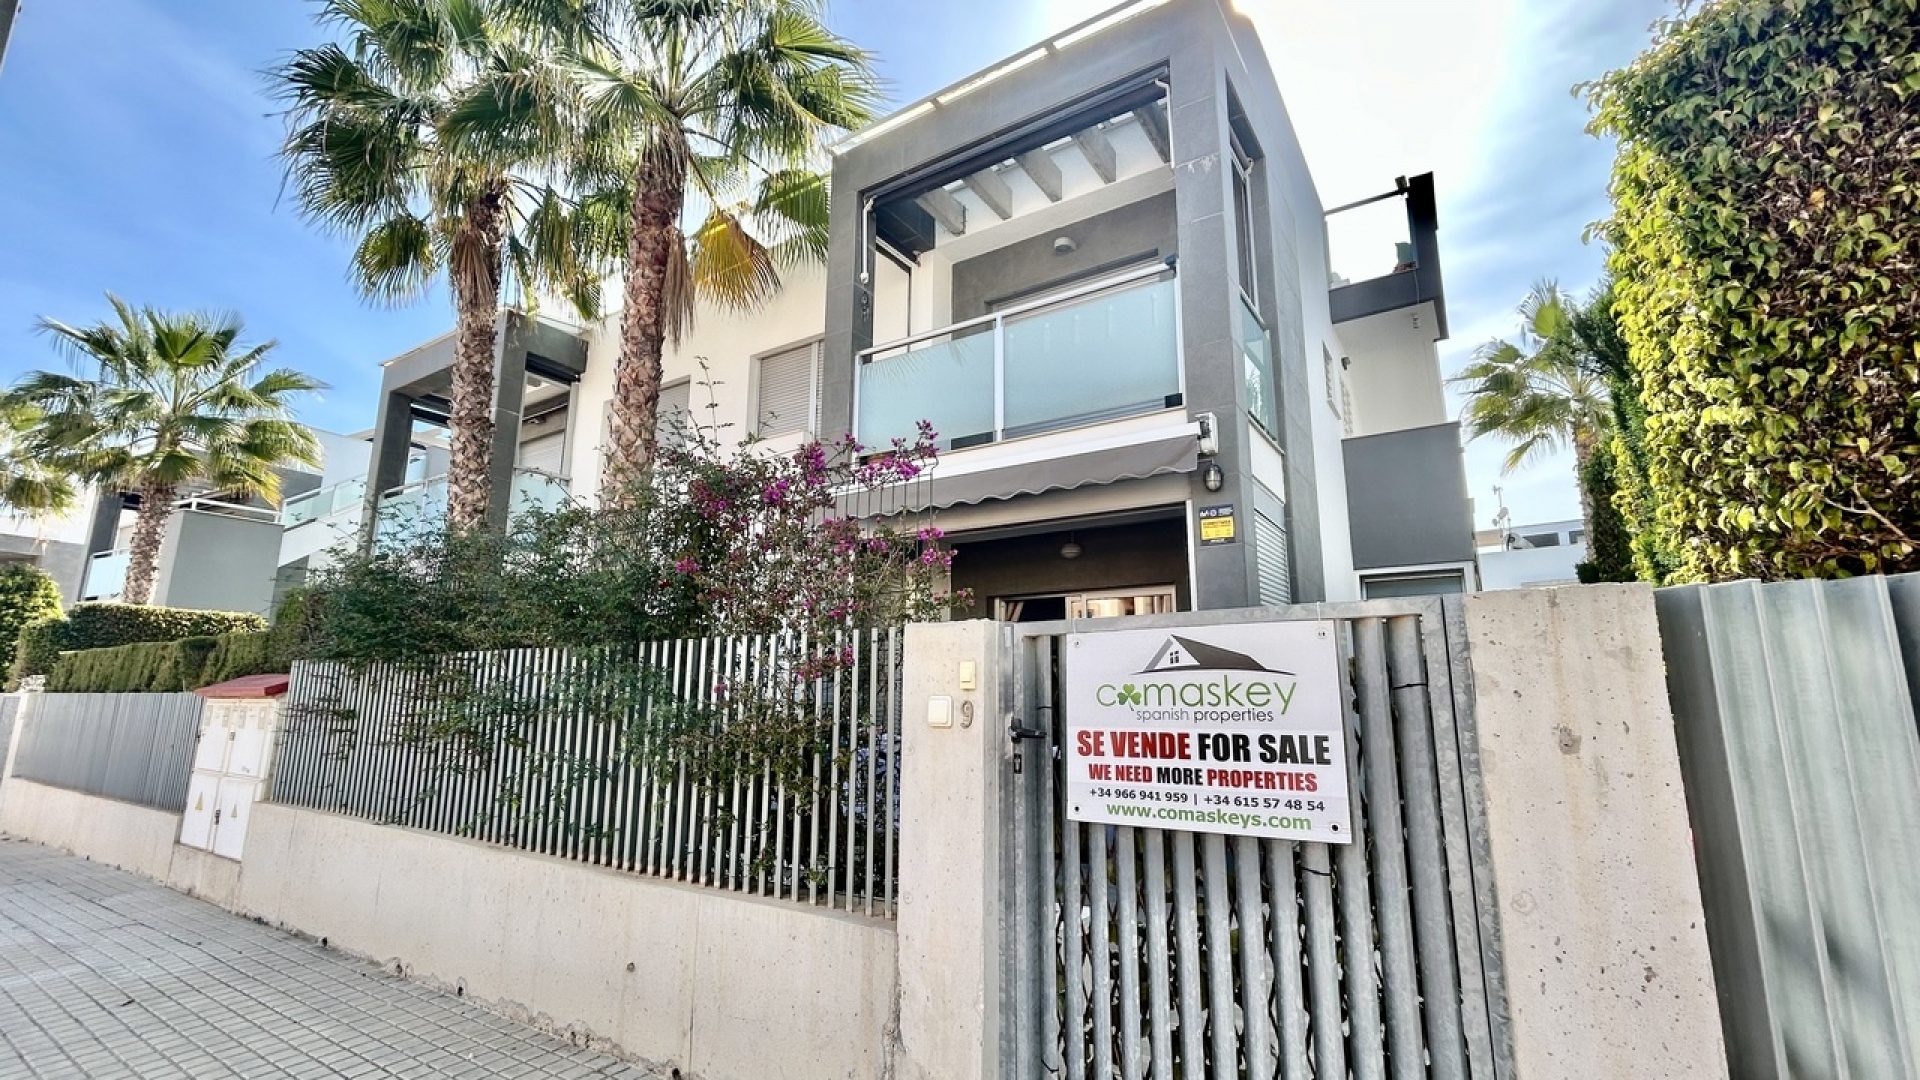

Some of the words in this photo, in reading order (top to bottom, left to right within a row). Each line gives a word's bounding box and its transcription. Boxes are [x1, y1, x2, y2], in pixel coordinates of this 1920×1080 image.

[960, 700, 974, 729] 9
[1136, 708, 1190, 723] spanish
[1194, 708, 1274, 723] properties
[1077, 730, 1105, 757] SE
[1110, 731, 1192, 760] VENDE
[1198, 733, 1251, 763] FOR
[1258, 734, 1331, 765] SALE
[1088, 764, 1112, 781] WE
[1115, 765, 1153, 783] NEED
[1157, 767, 1203, 786] MORE
[1207, 769, 1318, 792] PROPERTIES
[1090, 788, 1112, 798] +34
[1114, 789, 1136, 799] 966
[1139, 791, 1161, 801] 941
[1165, 792, 1188, 803] 959
[1204, 795, 1230, 806] +34
[1234, 796, 1259, 808] 615
[1263, 798, 1280, 809] 57
[1284, 799, 1303, 811] 48
[1307, 800, 1325, 812] 54
[1107, 803, 1313, 830] www.comaskeys.com
